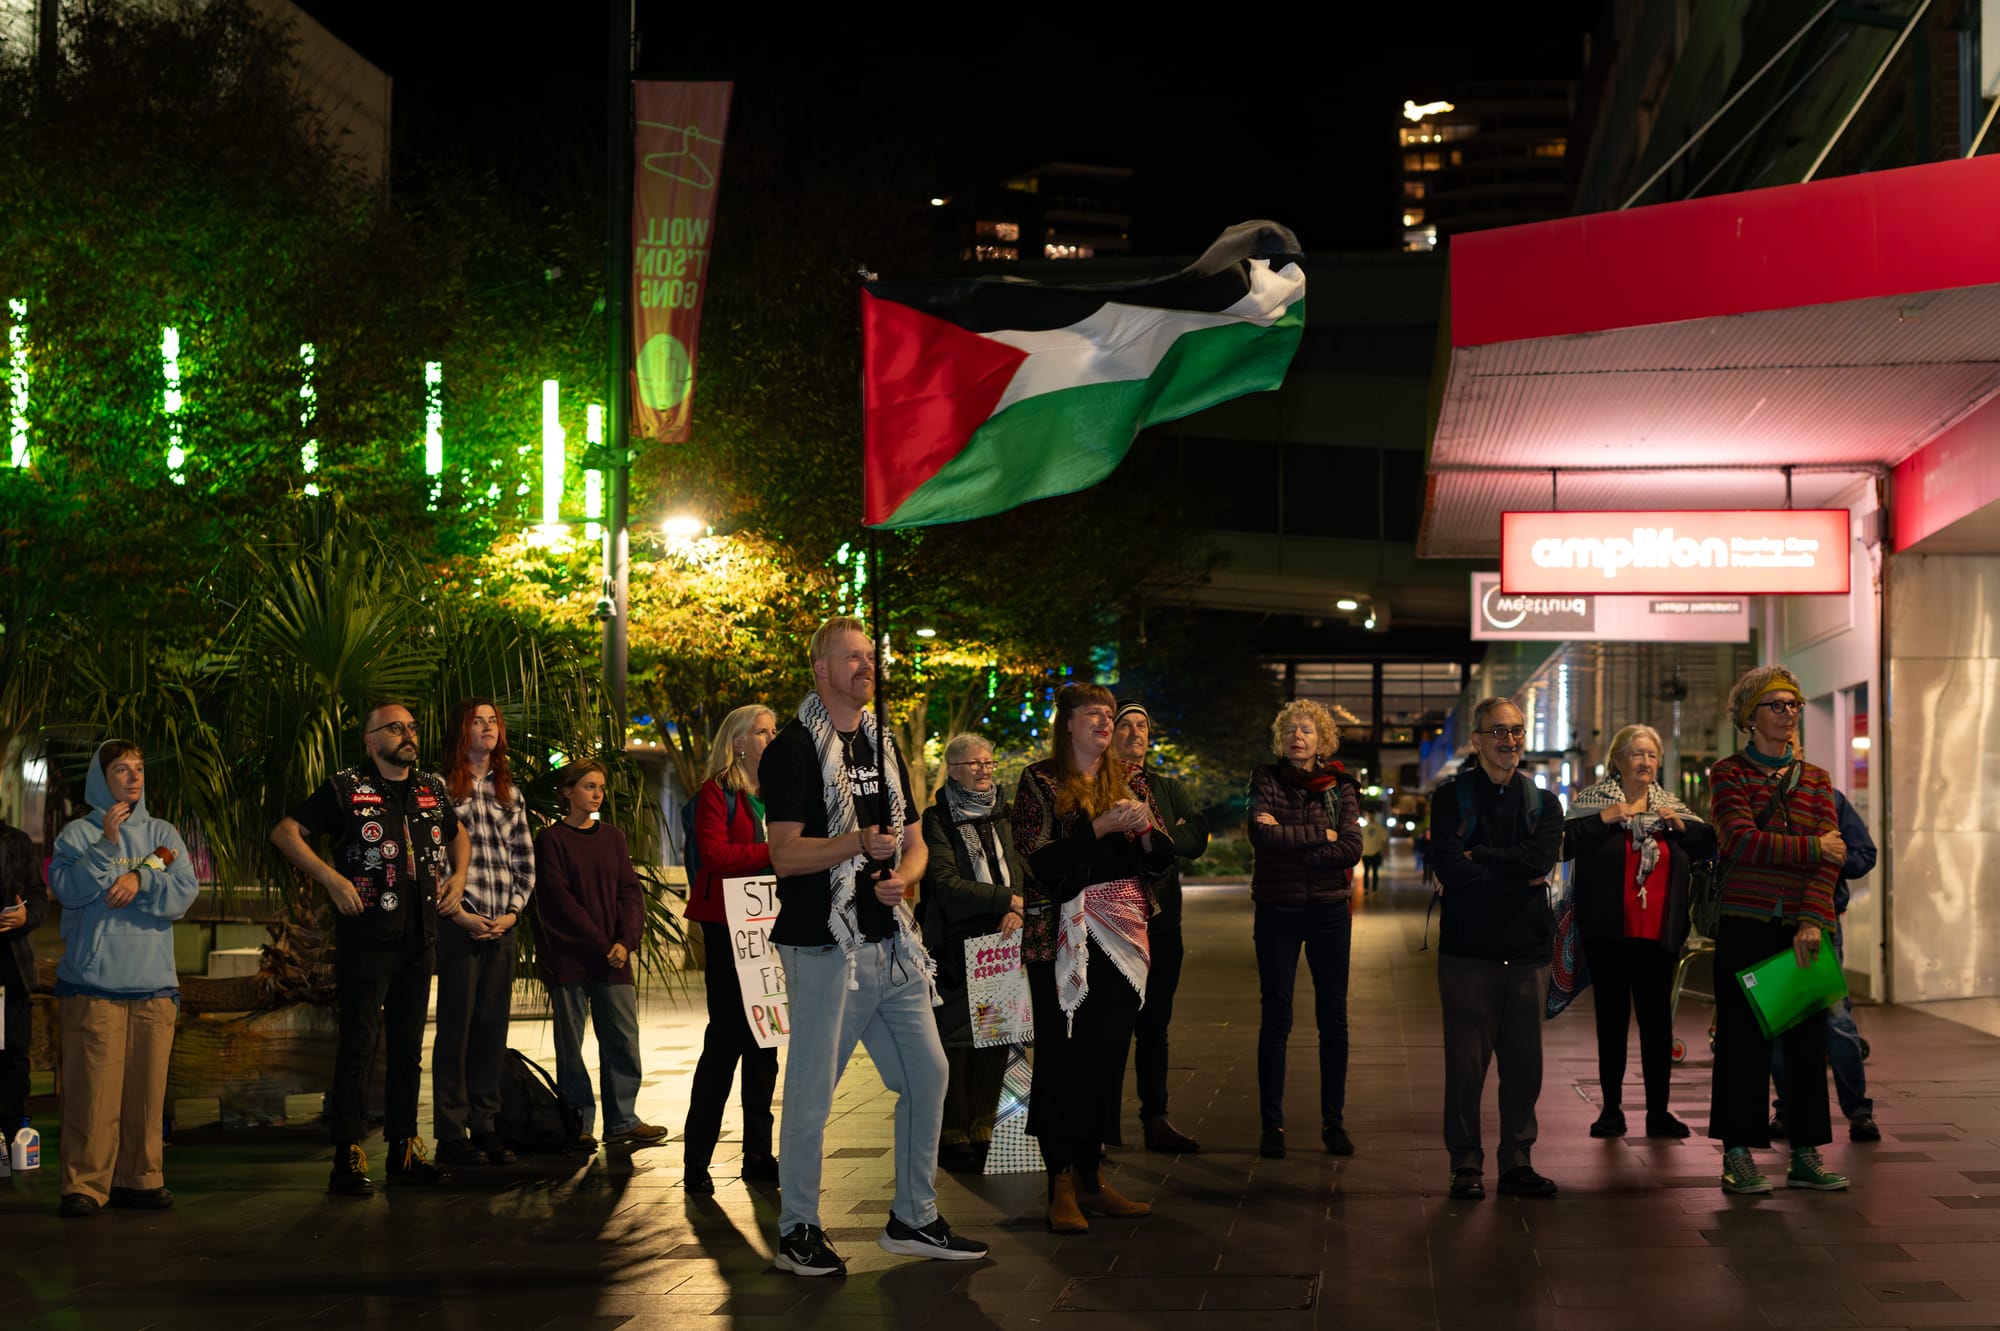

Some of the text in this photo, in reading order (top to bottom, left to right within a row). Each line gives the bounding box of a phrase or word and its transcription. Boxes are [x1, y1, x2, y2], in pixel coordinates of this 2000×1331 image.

[1531, 527, 1728, 578] amplifon
[863, 780, 879, 795] GAZ
[744, 881, 778, 917] ST
[735, 927, 774, 960] GEN
[760, 966, 786, 994] FR
[752, 1002, 792, 1040] PAL
